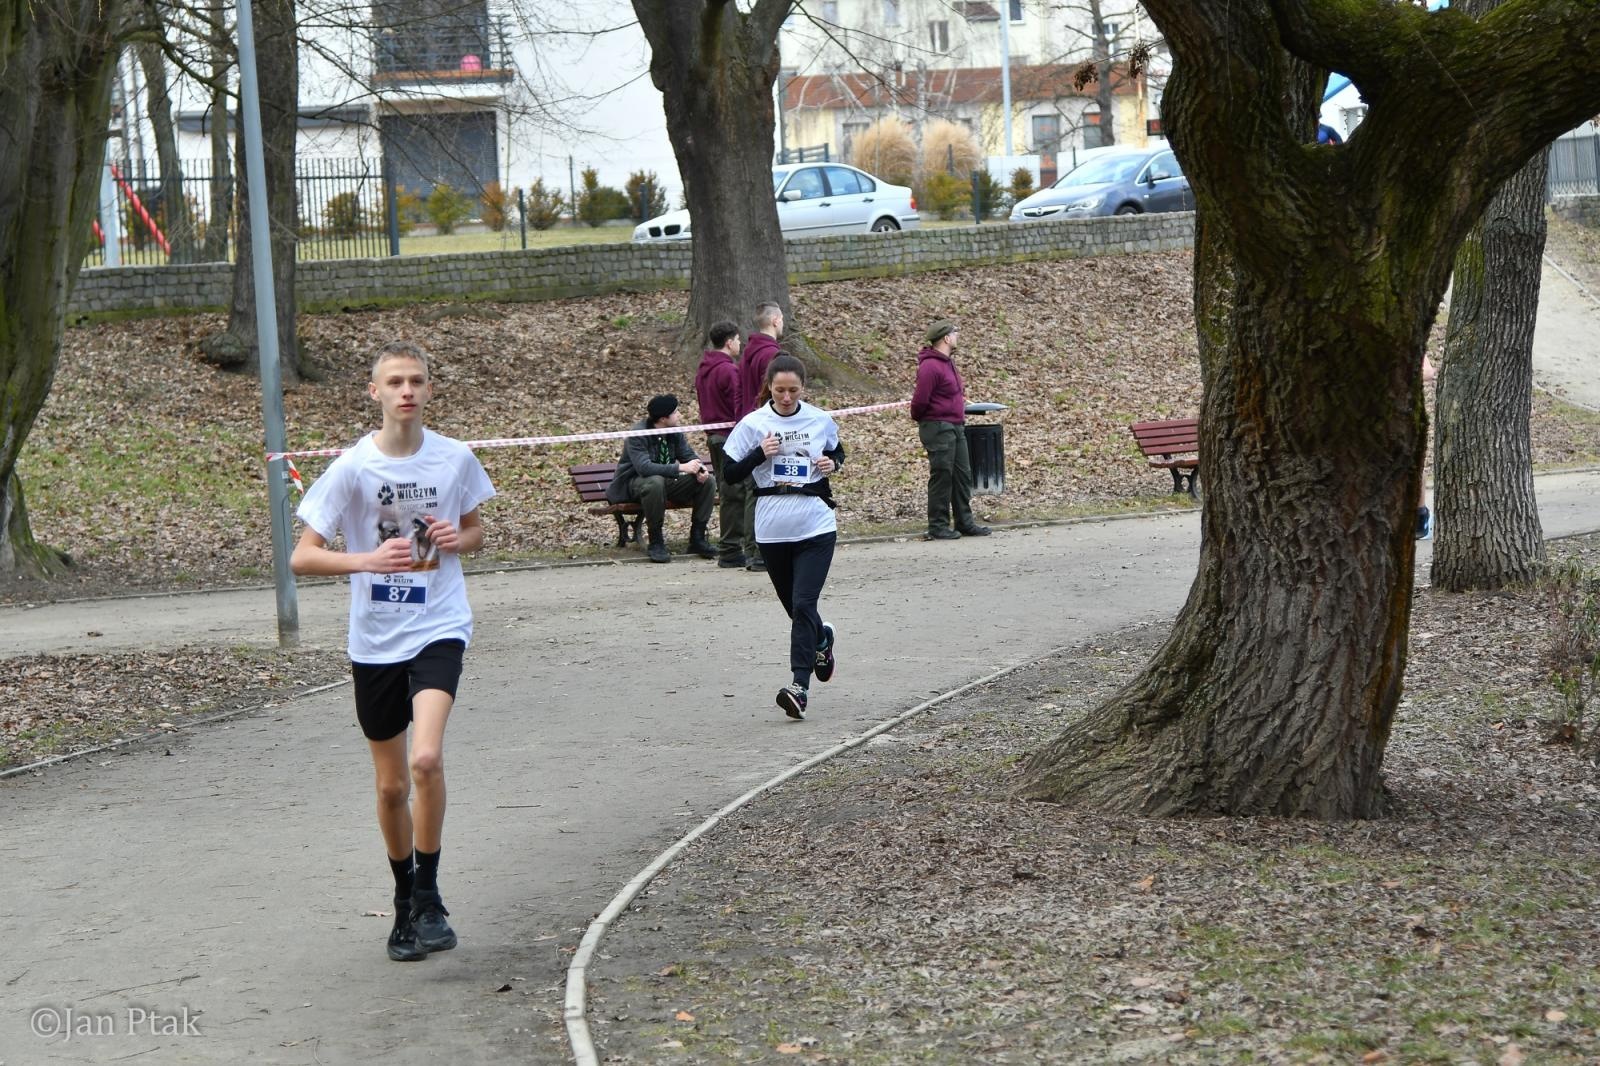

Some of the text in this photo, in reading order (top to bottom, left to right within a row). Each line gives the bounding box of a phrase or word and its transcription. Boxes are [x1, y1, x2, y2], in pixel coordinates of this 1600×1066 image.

[784, 465, 799, 476] 38
[397, 487, 437, 499] WILCZYM
[388, 586, 411, 602] 87
